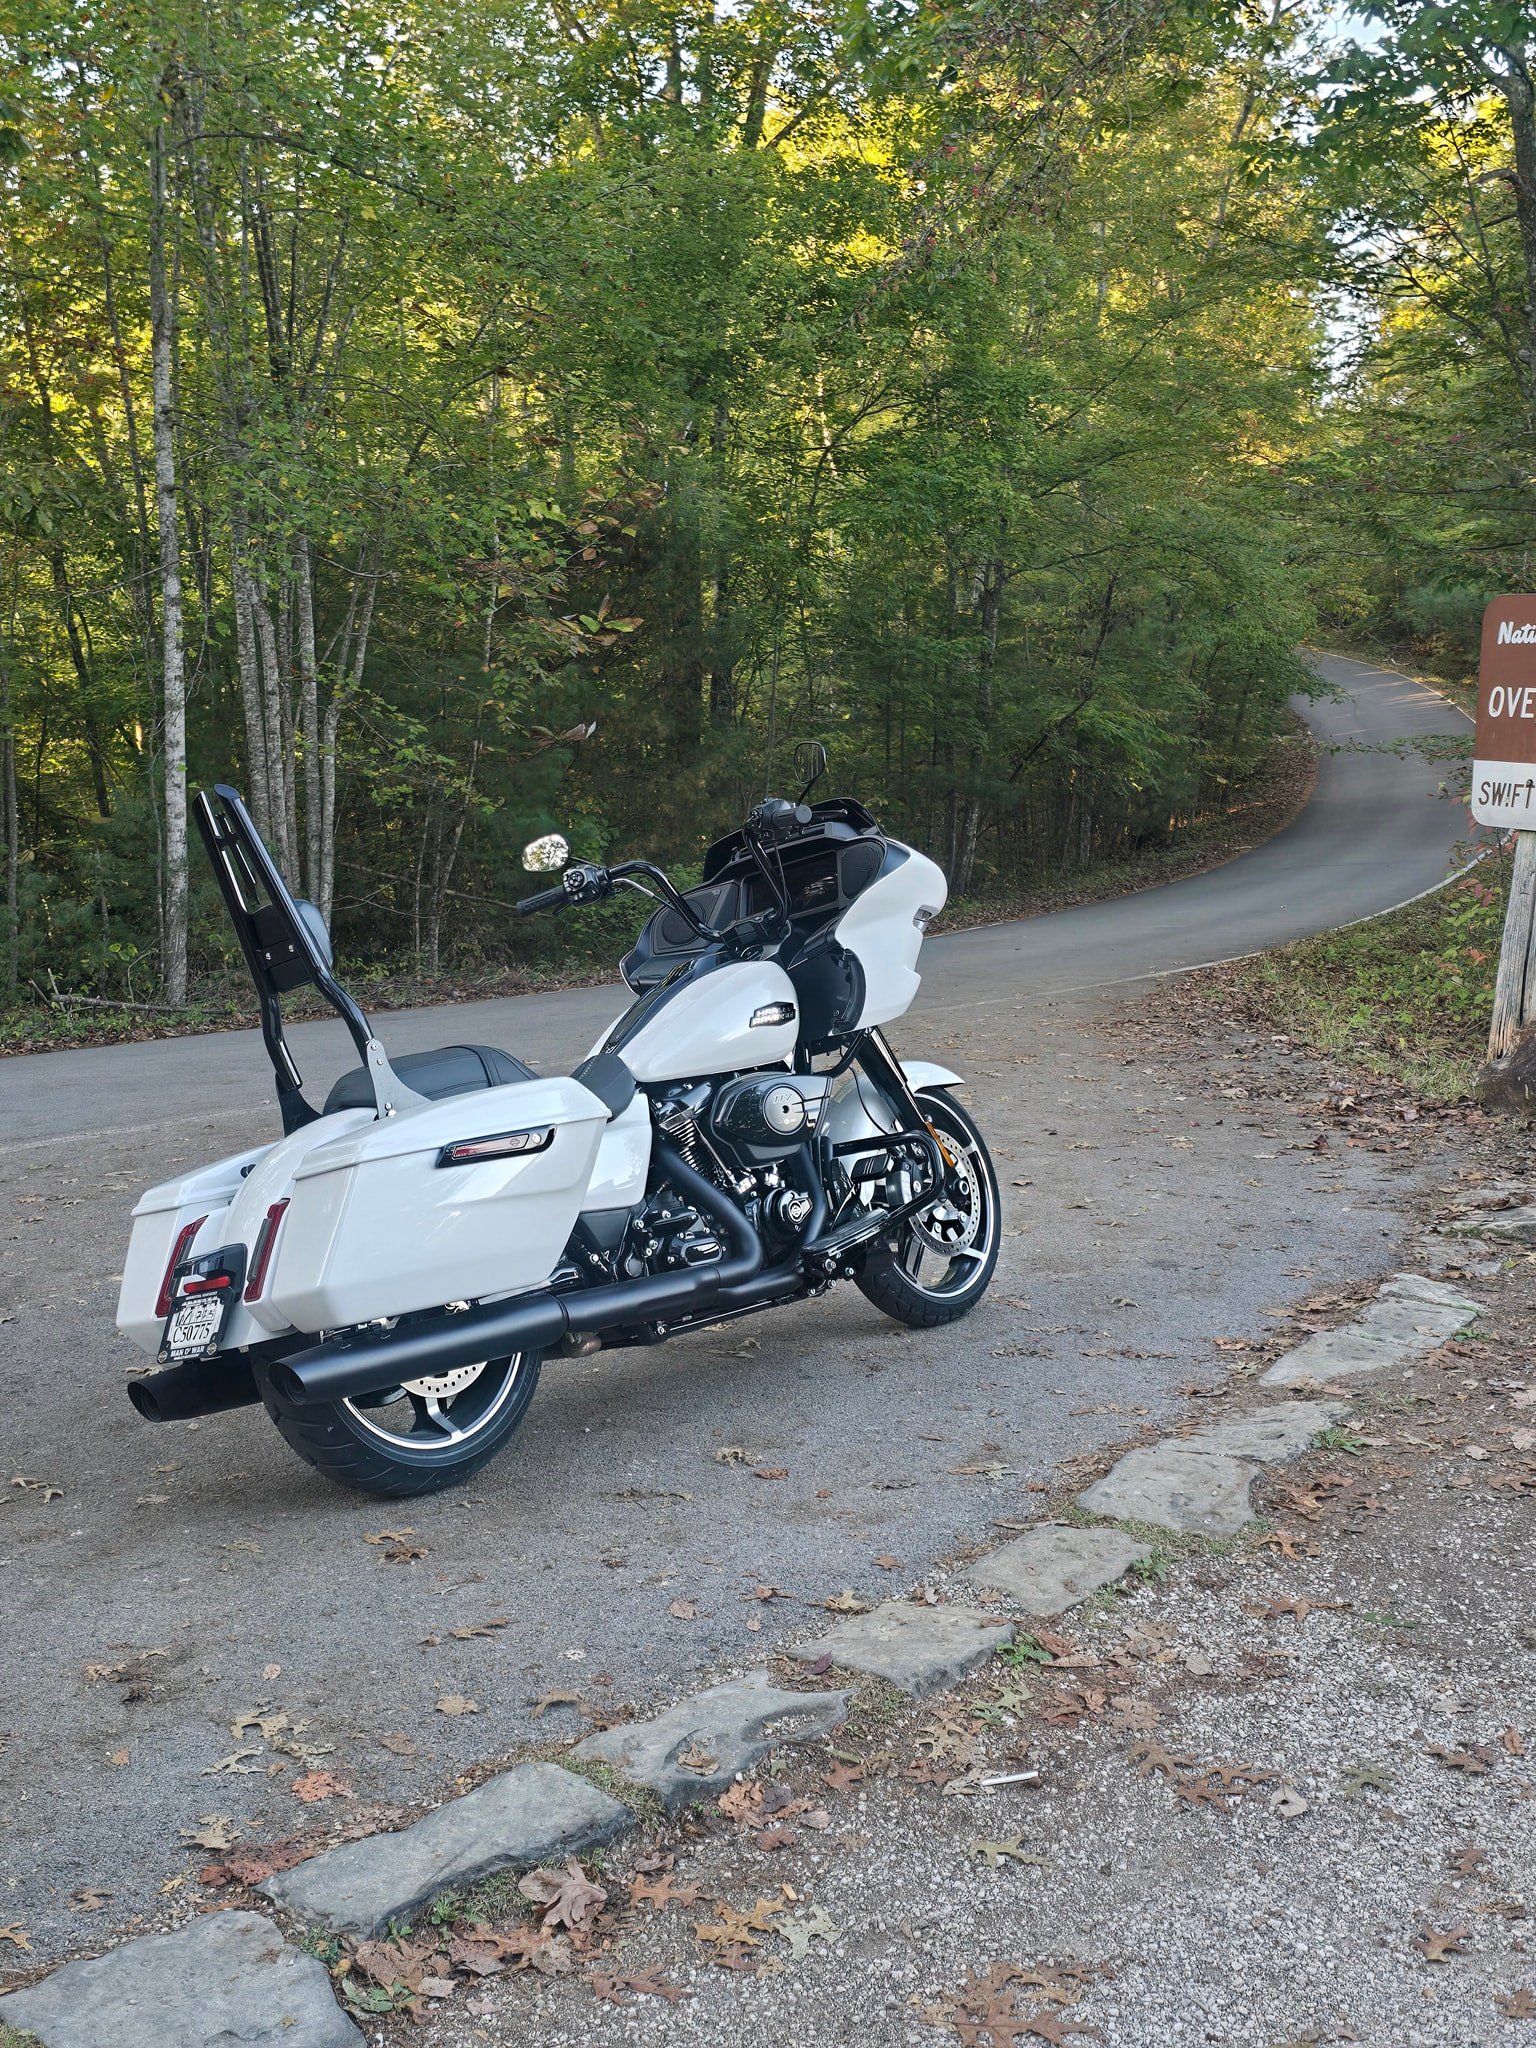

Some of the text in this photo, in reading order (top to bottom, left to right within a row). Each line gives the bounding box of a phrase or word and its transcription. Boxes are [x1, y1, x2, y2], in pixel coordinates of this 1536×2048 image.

[1488, 686, 1536, 718] OVE
[1478, 781, 1536, 808] SWIFT
[173, 1322, 213, 1343] C50775
[170, 1348, 184, 1358] MAN
